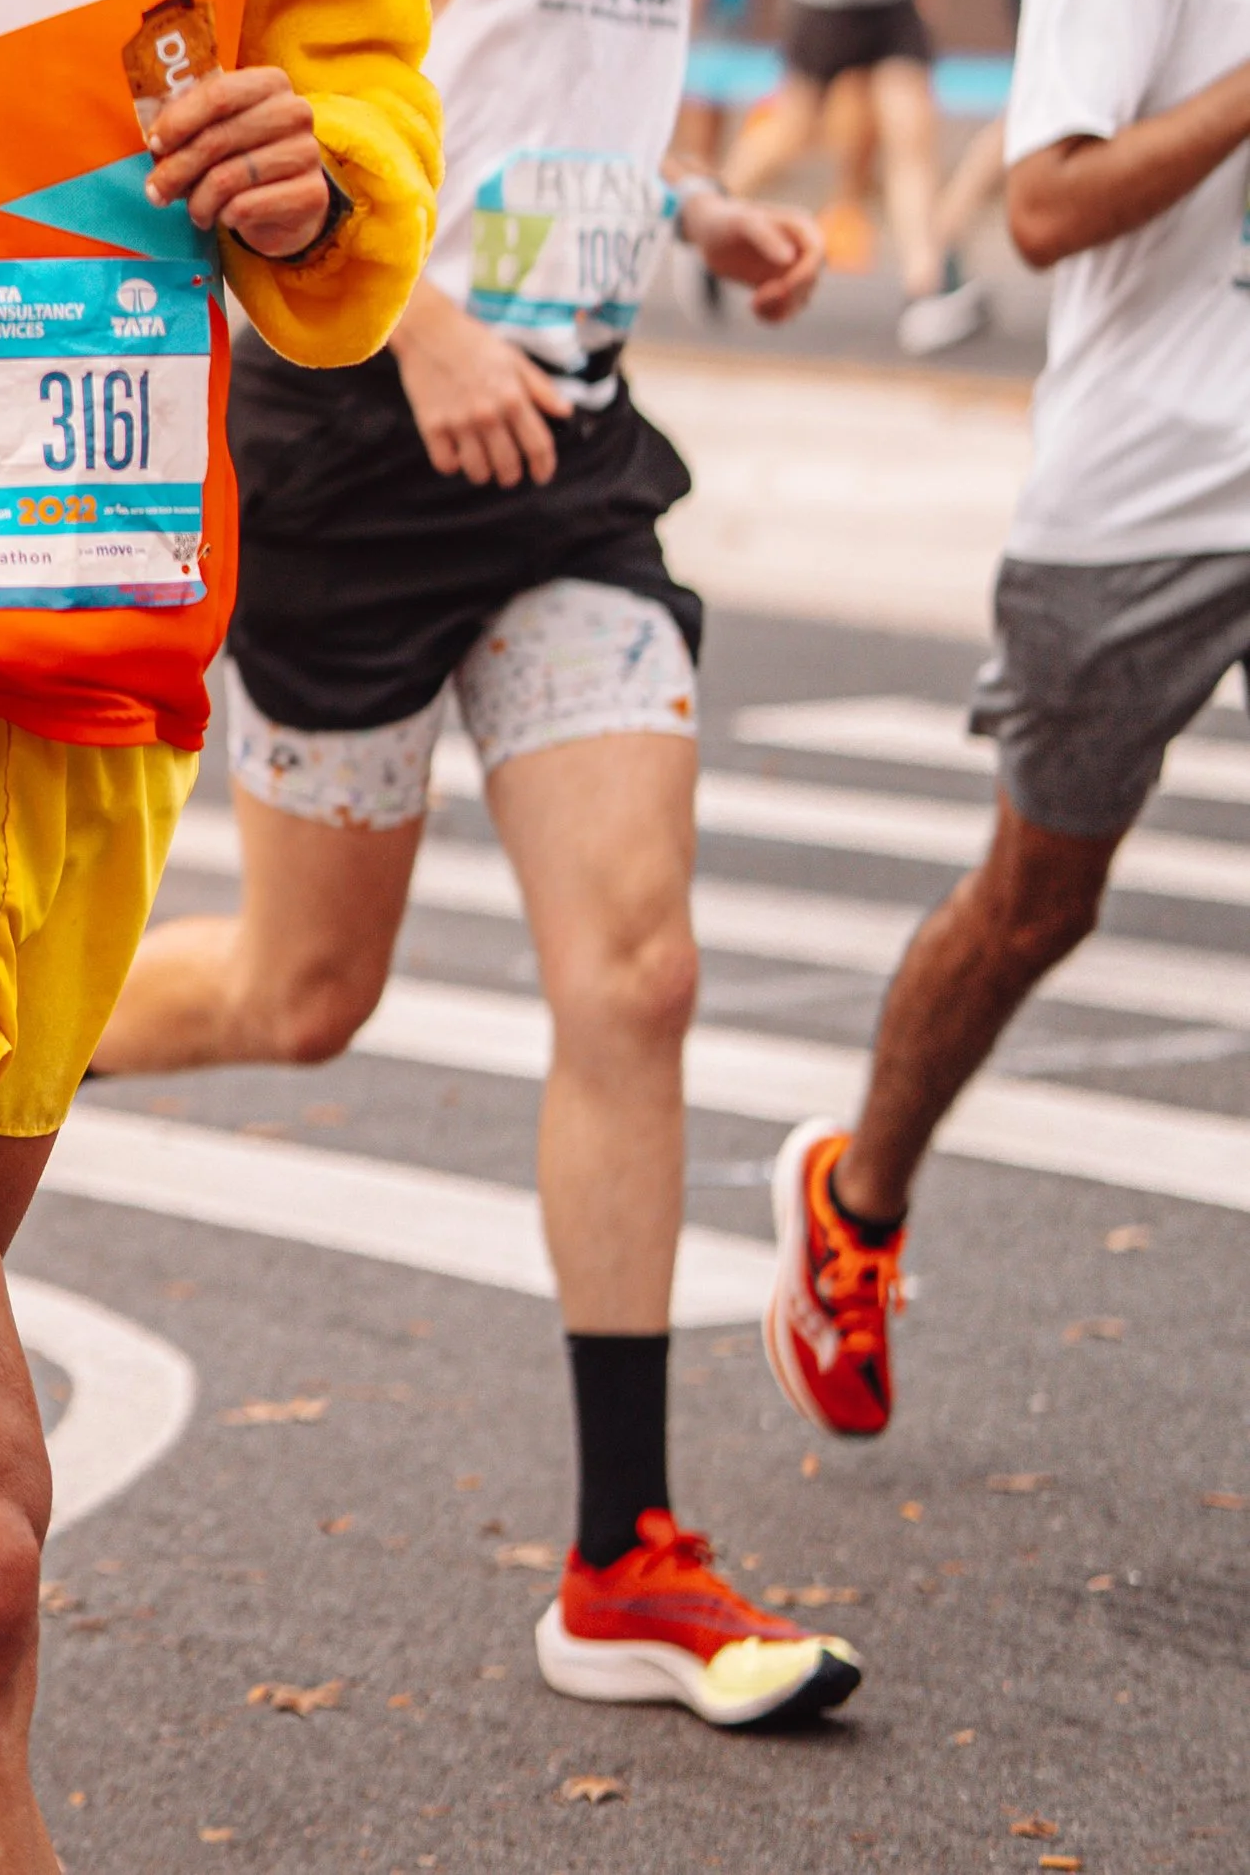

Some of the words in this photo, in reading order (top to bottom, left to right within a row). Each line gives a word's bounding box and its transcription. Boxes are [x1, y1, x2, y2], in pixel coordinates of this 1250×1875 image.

[110, 316, 166, 337] TATA
[39, 369, 150, 471] 3161
[17, 495, 98, 526] 2022
